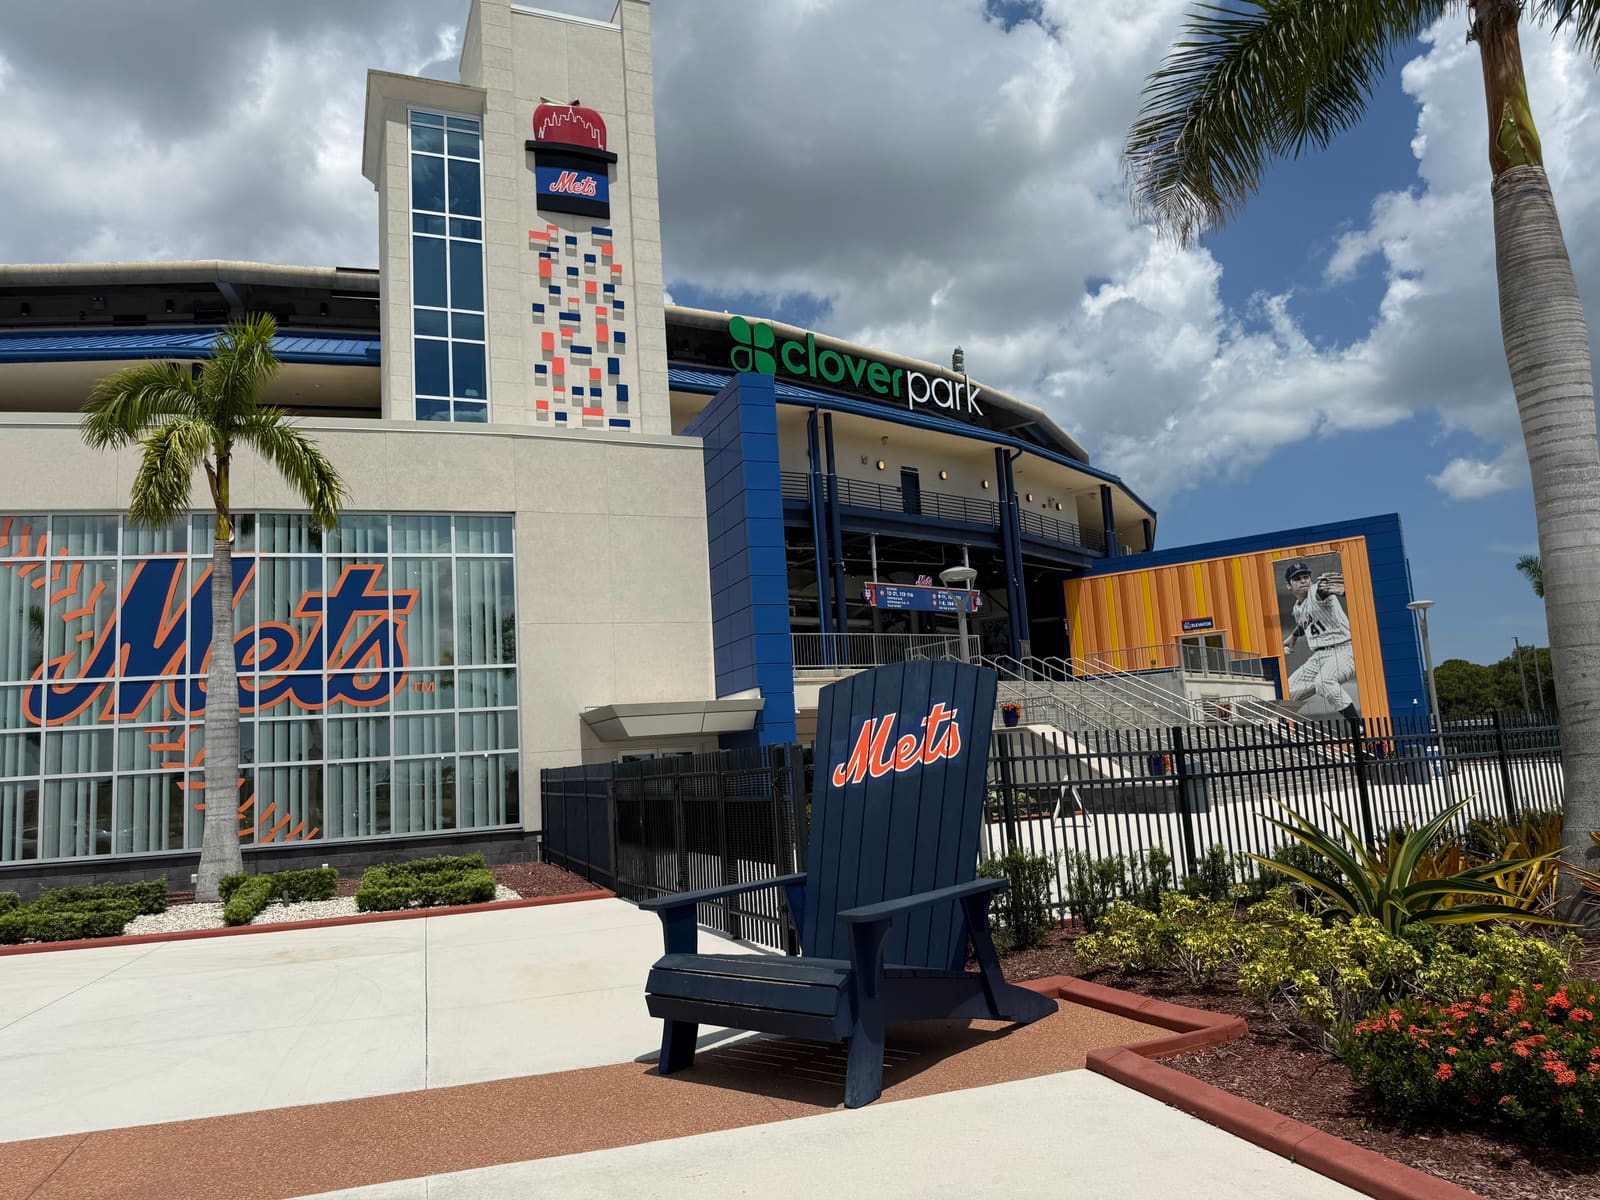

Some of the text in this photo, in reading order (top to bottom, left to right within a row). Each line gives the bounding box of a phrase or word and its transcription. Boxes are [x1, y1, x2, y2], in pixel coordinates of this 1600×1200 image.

[549, 171, 597, 196] Mets
[781, 332, 984, 417] clover park
[22, 551, 436, 726] Mets TM
[1310, 619, 1326, 636] 41
[832, 702, 962, 788] Mets
